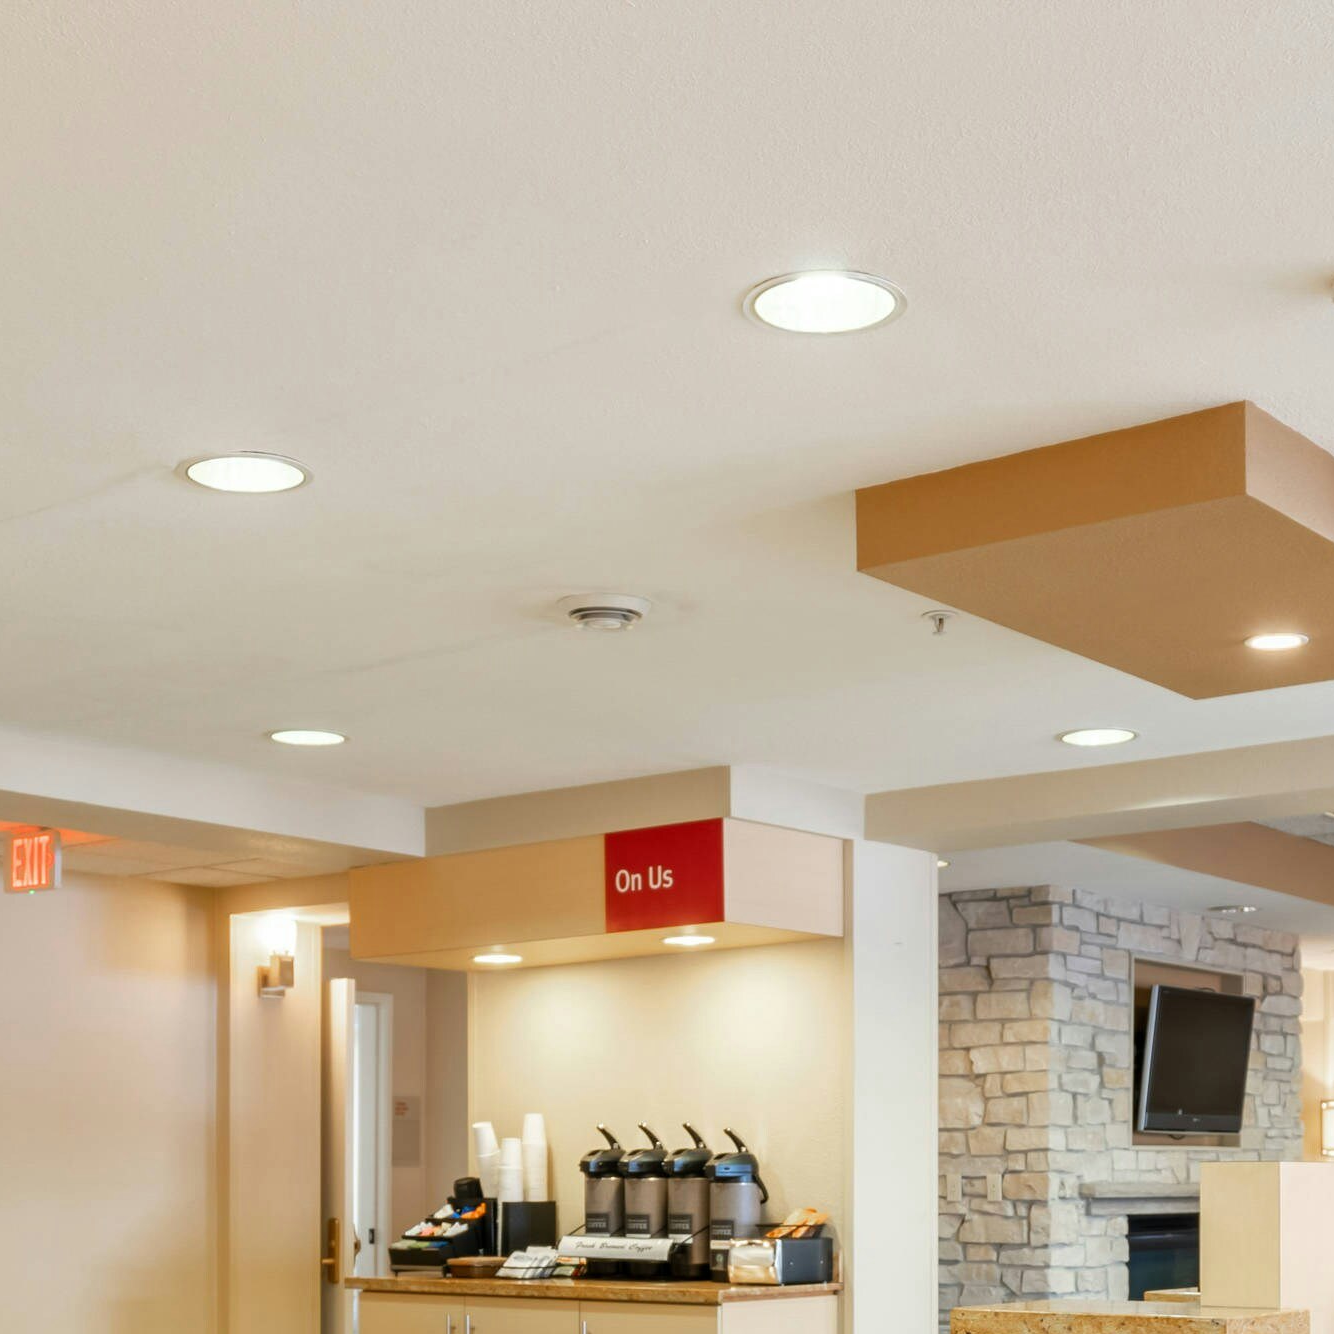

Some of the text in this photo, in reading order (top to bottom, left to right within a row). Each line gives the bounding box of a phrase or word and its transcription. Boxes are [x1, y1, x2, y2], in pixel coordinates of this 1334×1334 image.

[12, 835, 50, 887] EXIT
[615, 865, 674, 893] On Us
